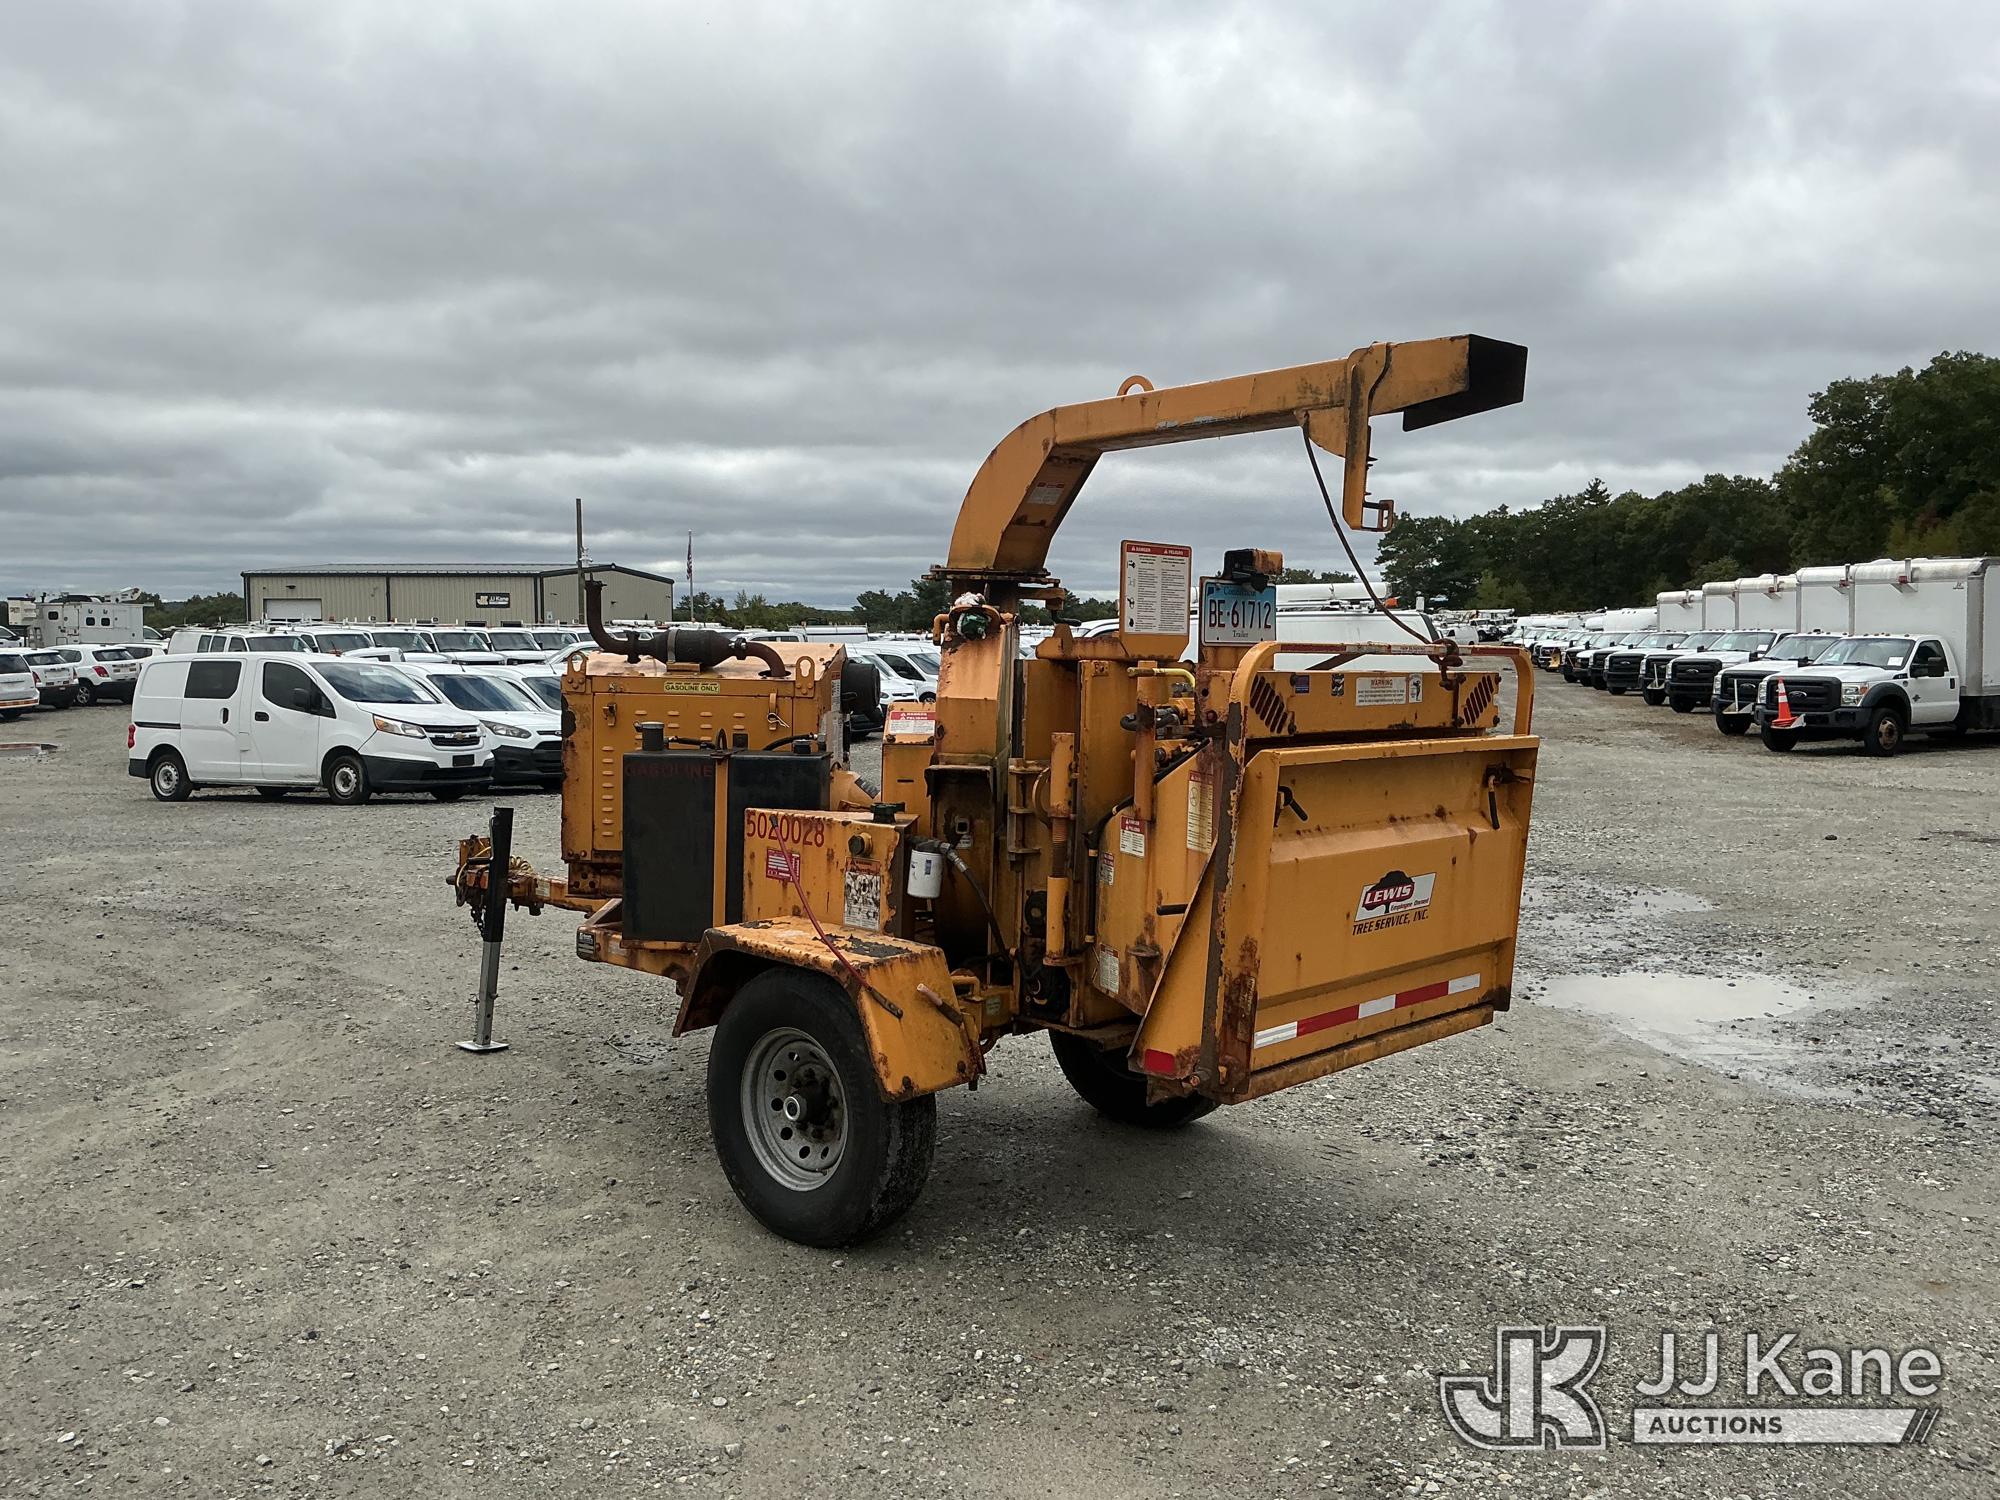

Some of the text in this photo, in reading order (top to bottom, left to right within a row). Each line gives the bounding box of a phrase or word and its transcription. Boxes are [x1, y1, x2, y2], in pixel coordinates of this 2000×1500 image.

[746, 810, 825, 848] 5020028
[1364, 885, 1413, 905] LEWIS
[1352, 909, 1429, 936] TREE SERVICE, INC.
